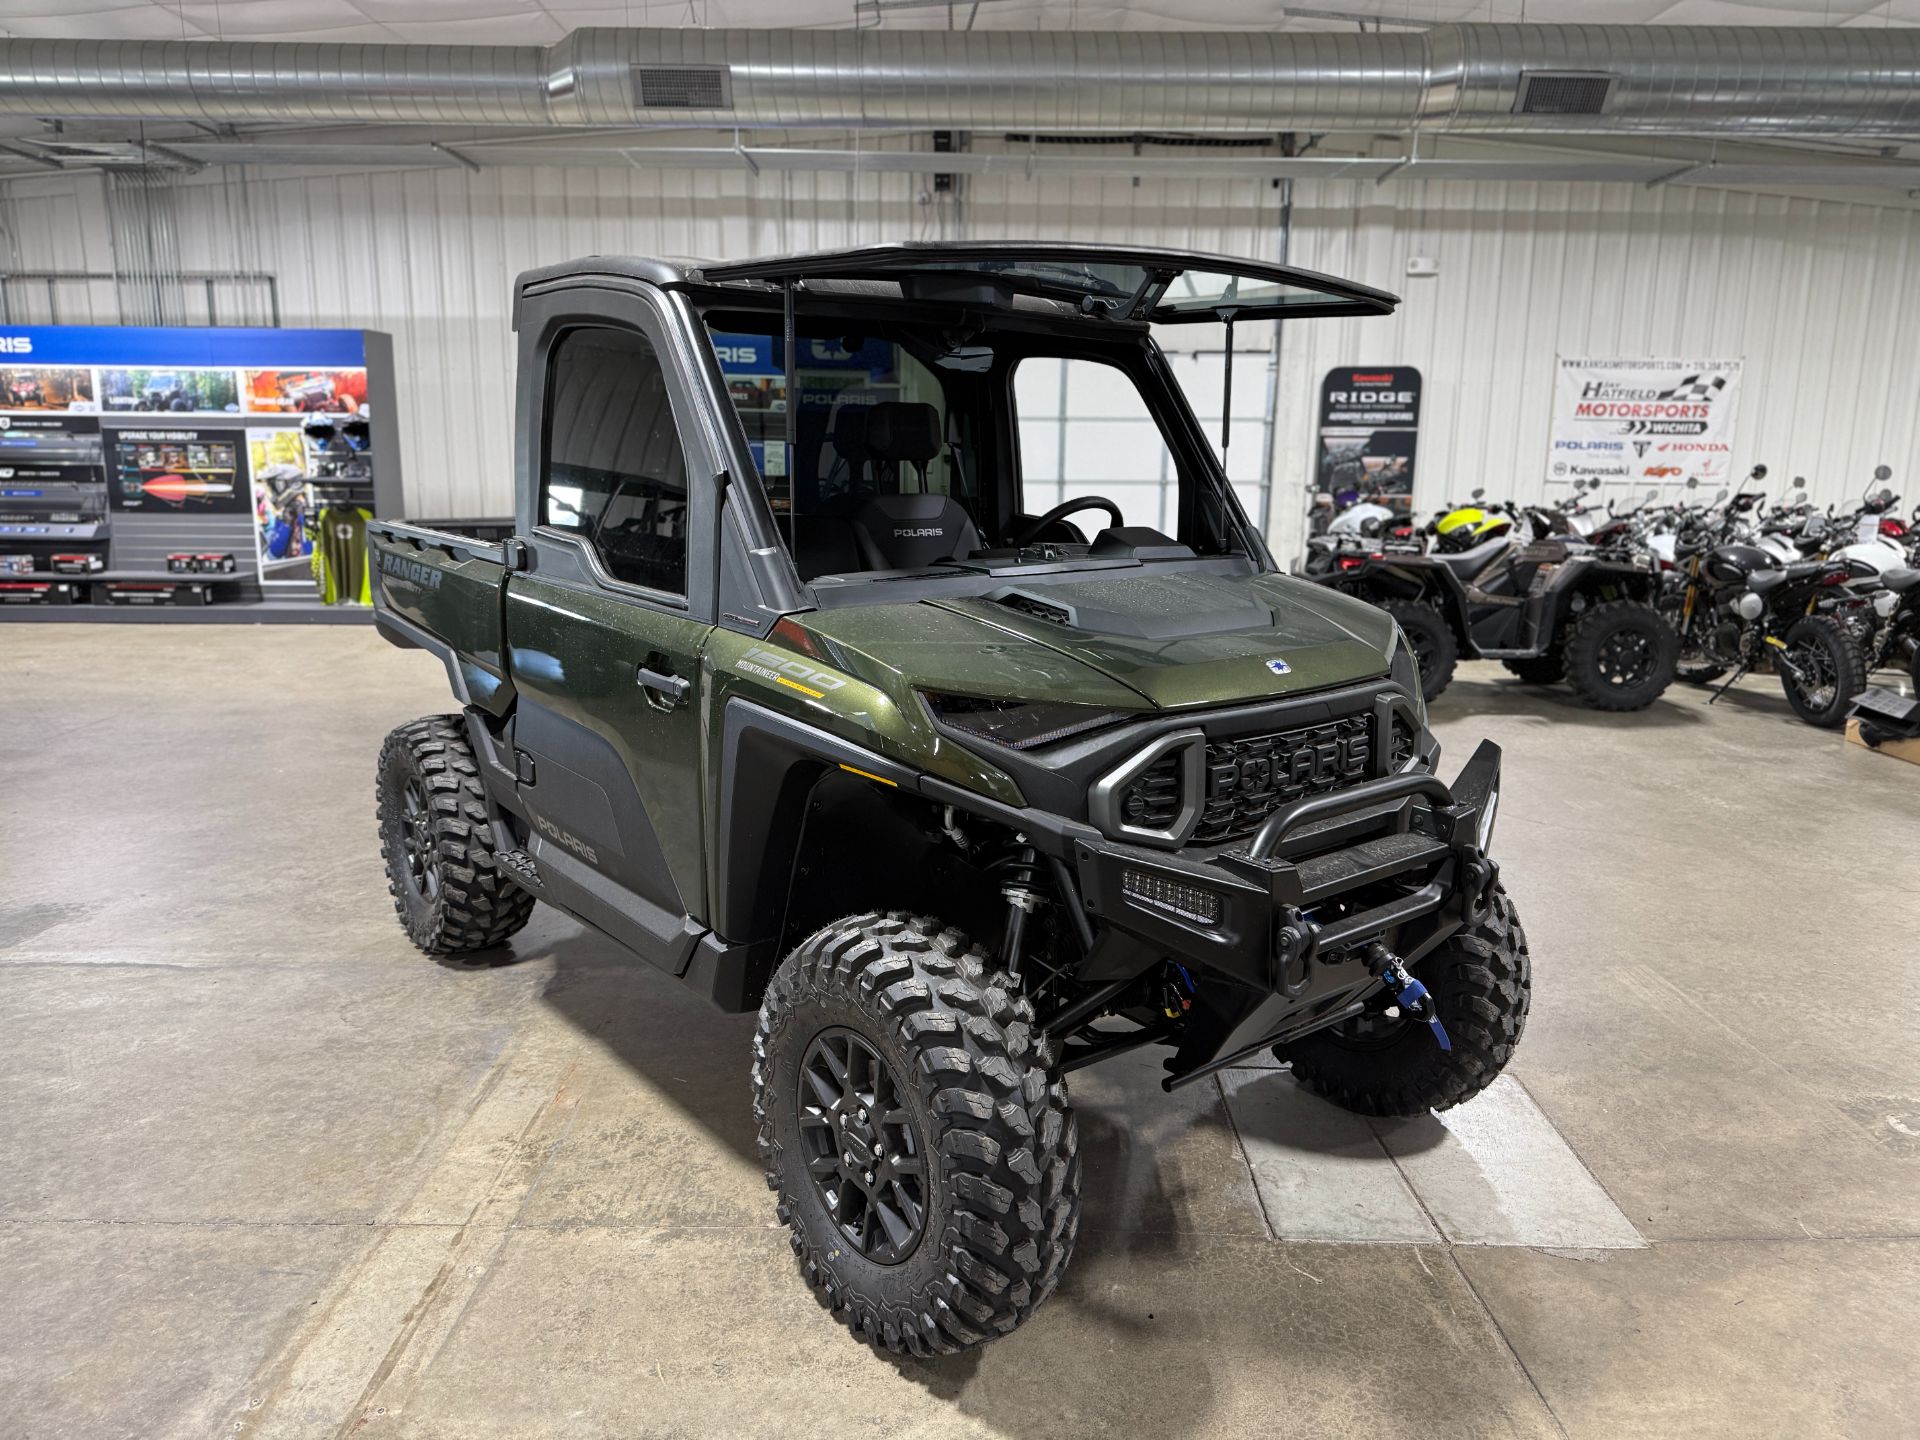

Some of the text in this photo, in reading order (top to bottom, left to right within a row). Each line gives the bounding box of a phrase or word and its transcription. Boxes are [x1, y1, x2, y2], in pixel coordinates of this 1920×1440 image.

[1582, 381, 1657, 399] HATFIELD
[802, 394, 878, 405] POLARIS
[1329, 391, 1413, 403] RIDGE
[1575, 403, 1711, 417] MOTORSPORTS
[1652, 422, 1702, 434] WICHITA
[1555, 441, 1625, 450] POLARIS
[1673, 443, 1729, 452] HONDA
[1570, 465, 1630, 476] Kawasaki
[894, 527, 943, 537] POLARIS
[383, 553, 442, 589] RANGER
[735, 660, 780, 682] MOUNTAINEER
[742, 647, 847, 690] 1500
[1211, 734, 1370, 798] POLARIS
[537, 815, 598, 865] POLARIS
